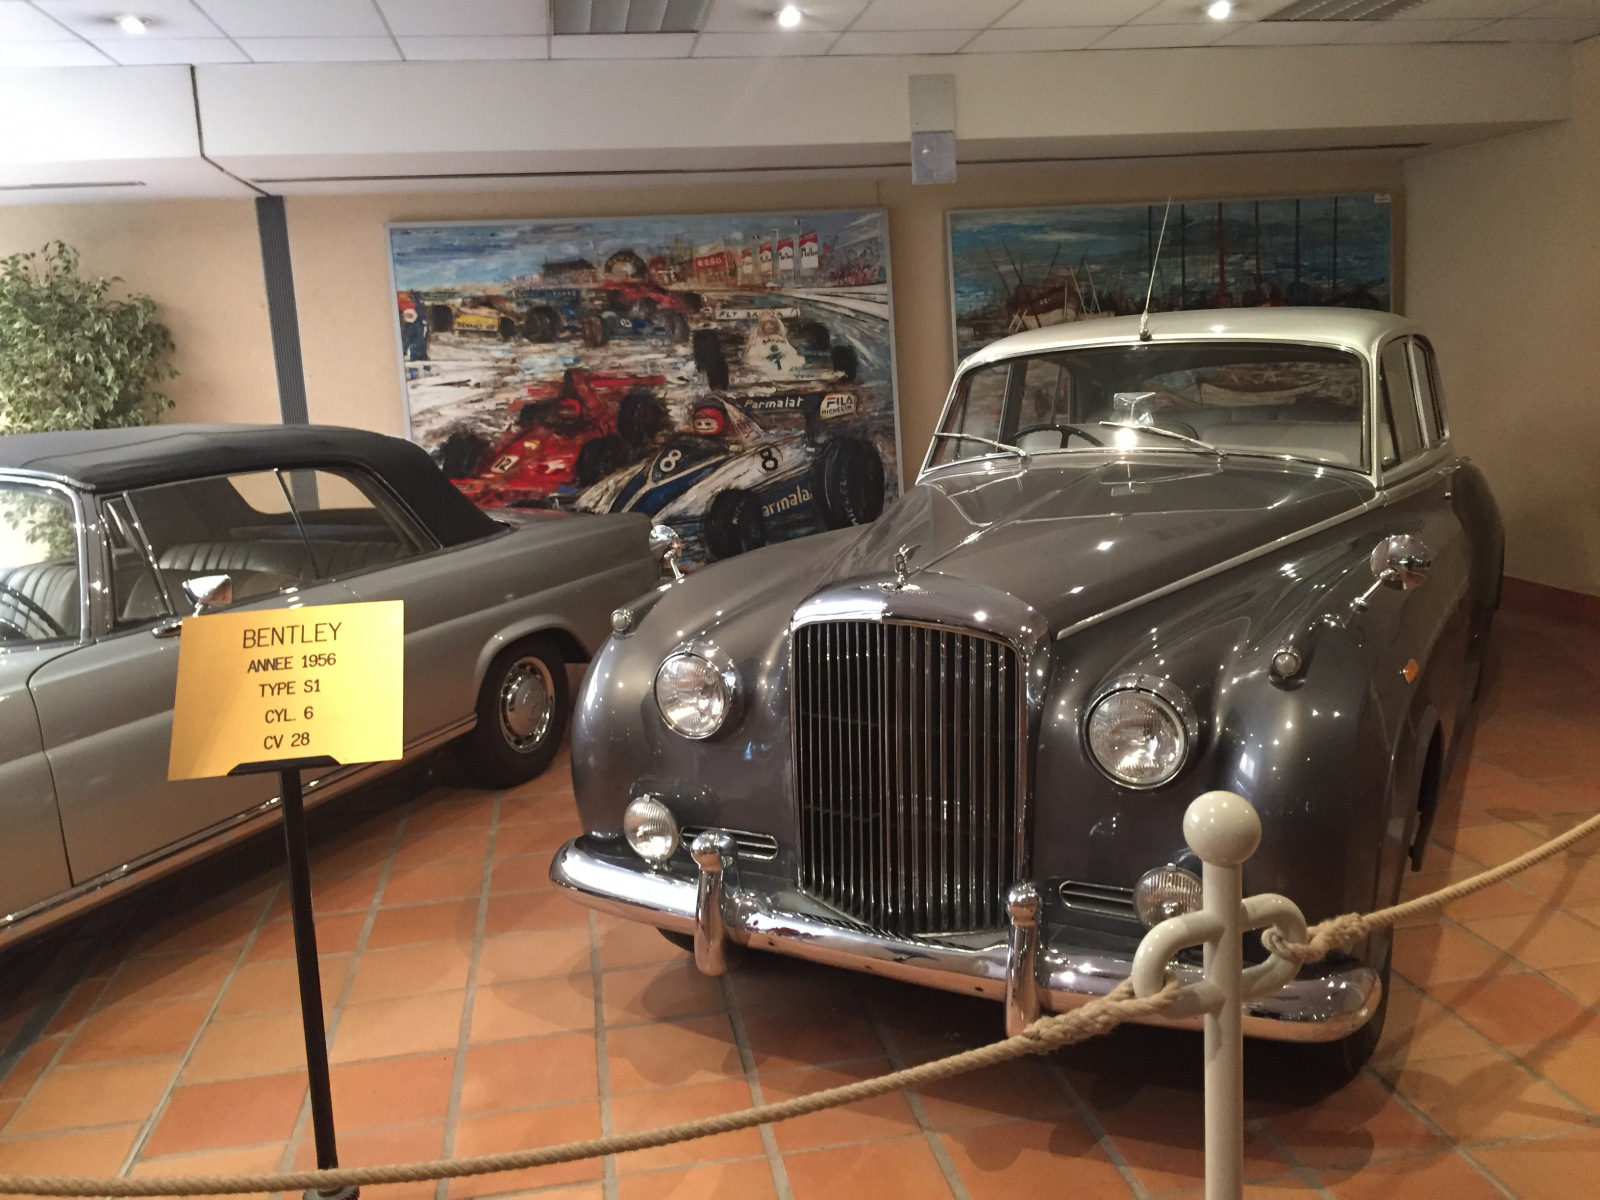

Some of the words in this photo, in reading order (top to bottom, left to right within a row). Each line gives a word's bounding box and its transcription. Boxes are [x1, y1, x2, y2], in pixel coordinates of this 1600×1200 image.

[697, 257, 722, 267] ESSO
[718, 310, 738, 318] FLY
[744, 396, 804, 409] Parmalat
[821, 405, 852, 415] MICHELIN
[826, 396, 854, 408] FILA
[494, 456, 512, 471] 12
[660, 449, 682, 472] 8
[760, 447, 779, 471] 8
[242, 622, 342, 649] BENTLEY
[247, 656, 293, 674] ANNEE
[301, 653, 336, 669] 1956
[259, 681, 296, 697] TYPE
[303, 679, 321, 693] S1
[265, 708, 296, 724] CYL.
[303, 706, 314, 720] 6
[263, 735, 284, 750] CV
[291, 732, 310, 748] 28
